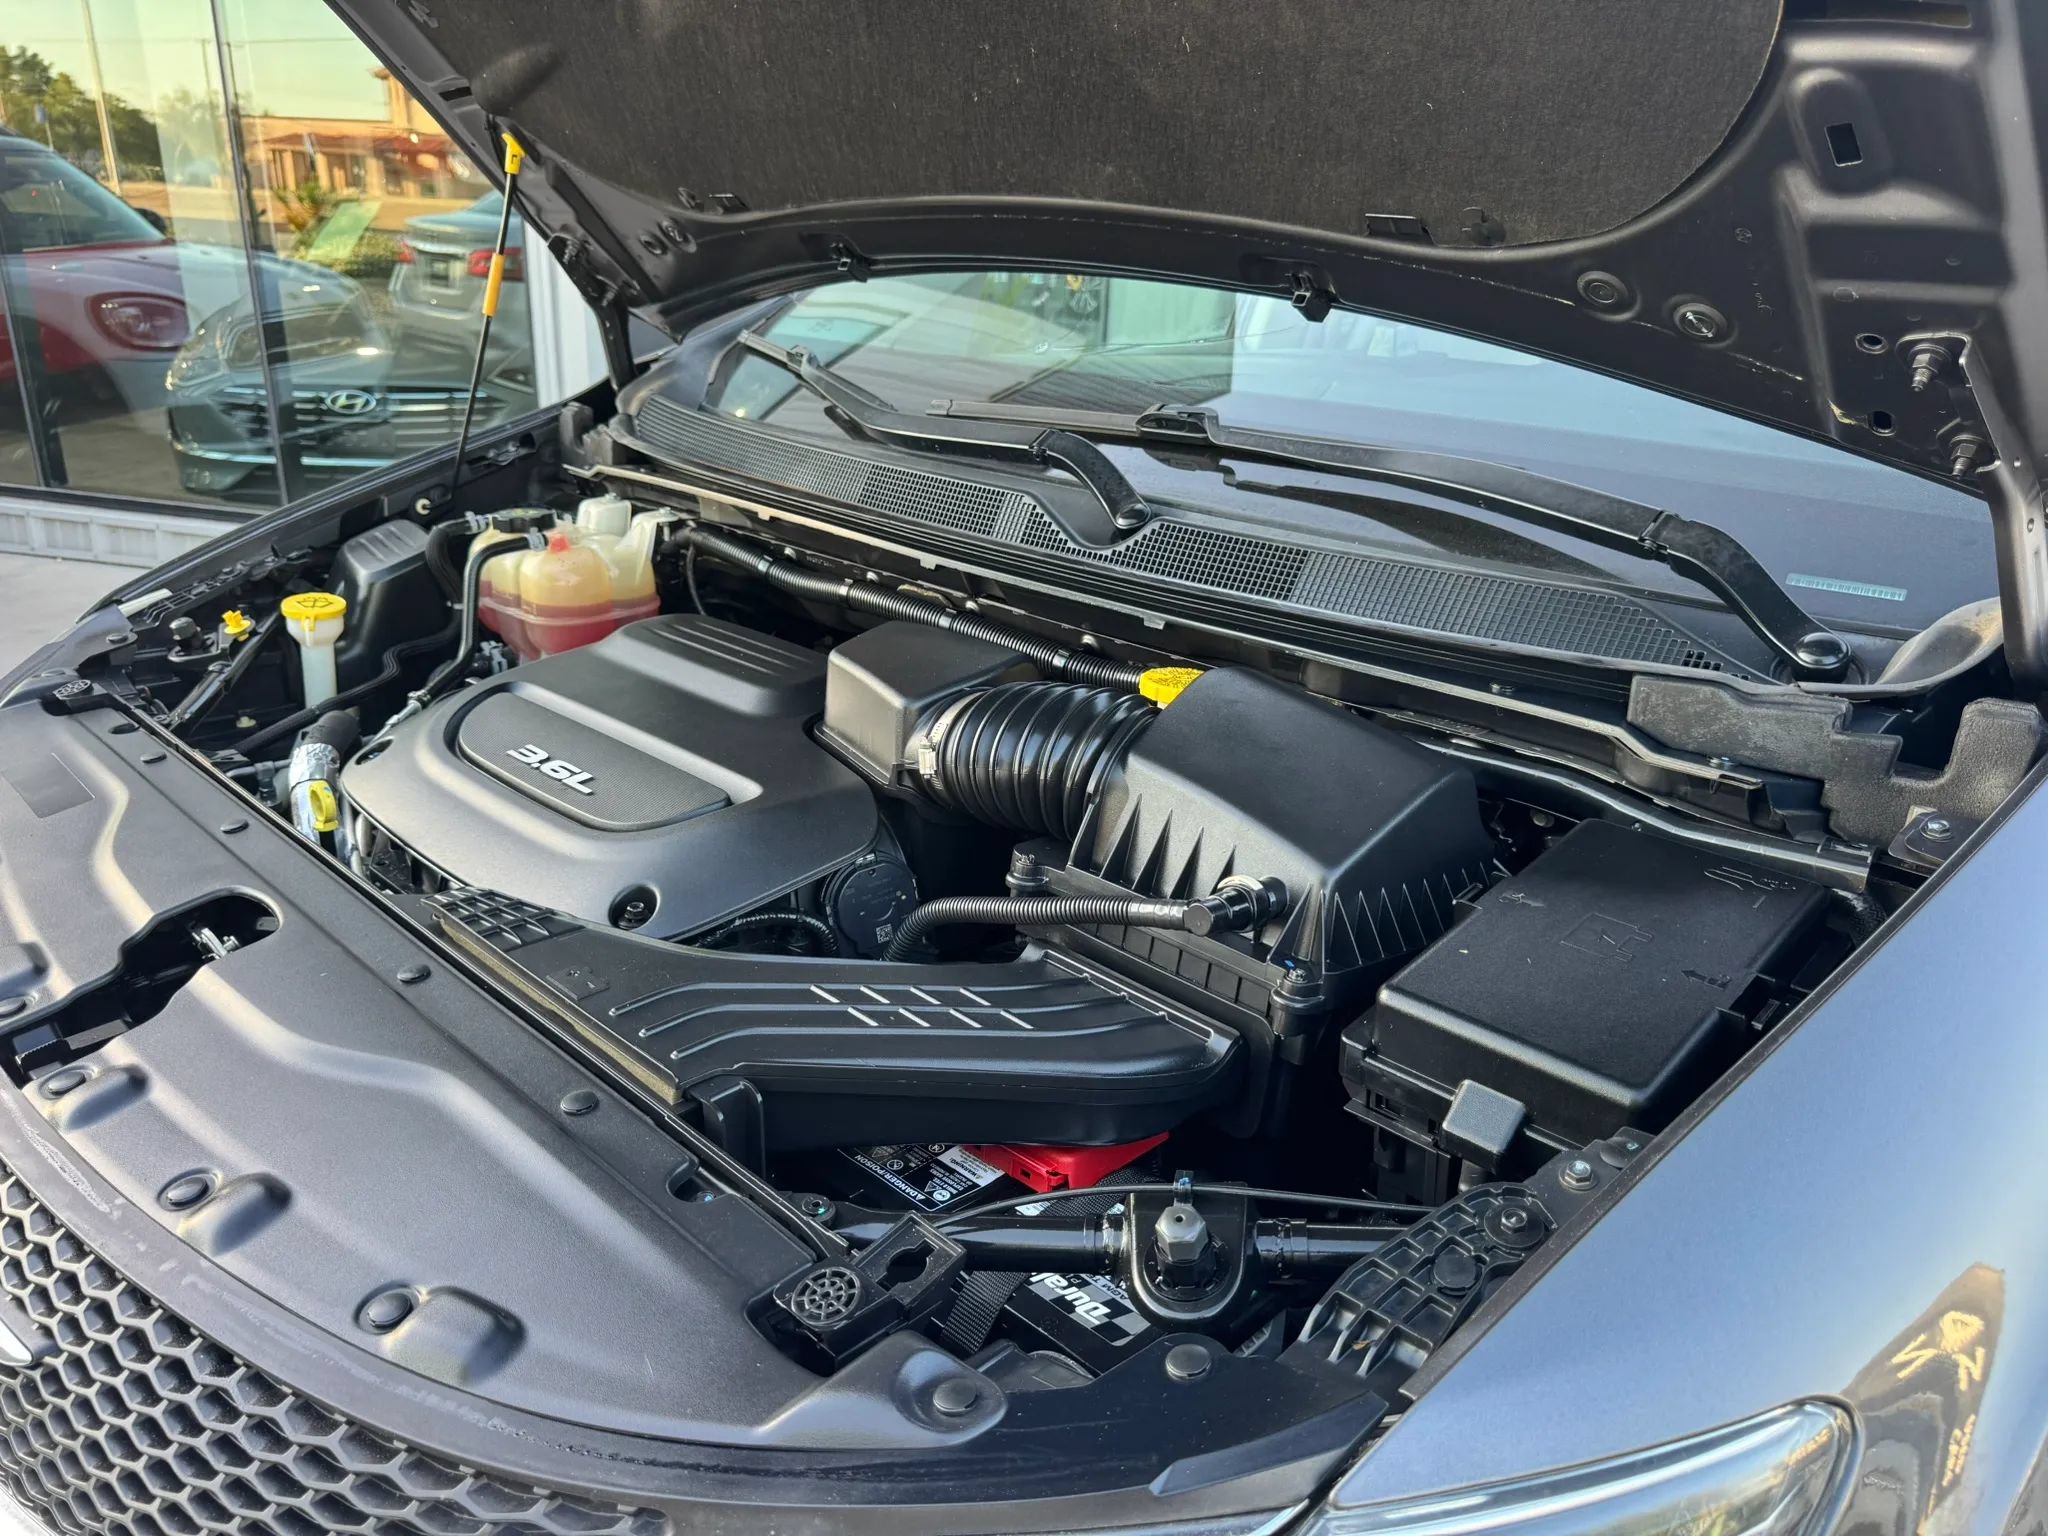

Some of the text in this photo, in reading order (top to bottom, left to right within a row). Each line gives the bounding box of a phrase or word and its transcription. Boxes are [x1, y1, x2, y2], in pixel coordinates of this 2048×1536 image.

[505, 744, 593, 795] 3.6L
[854, 1153, 919, 1200] DANGER/POISON
[1030, 1273, 1111, 1325] Dural
[1101, 1283, 1130, 1300] AGM
